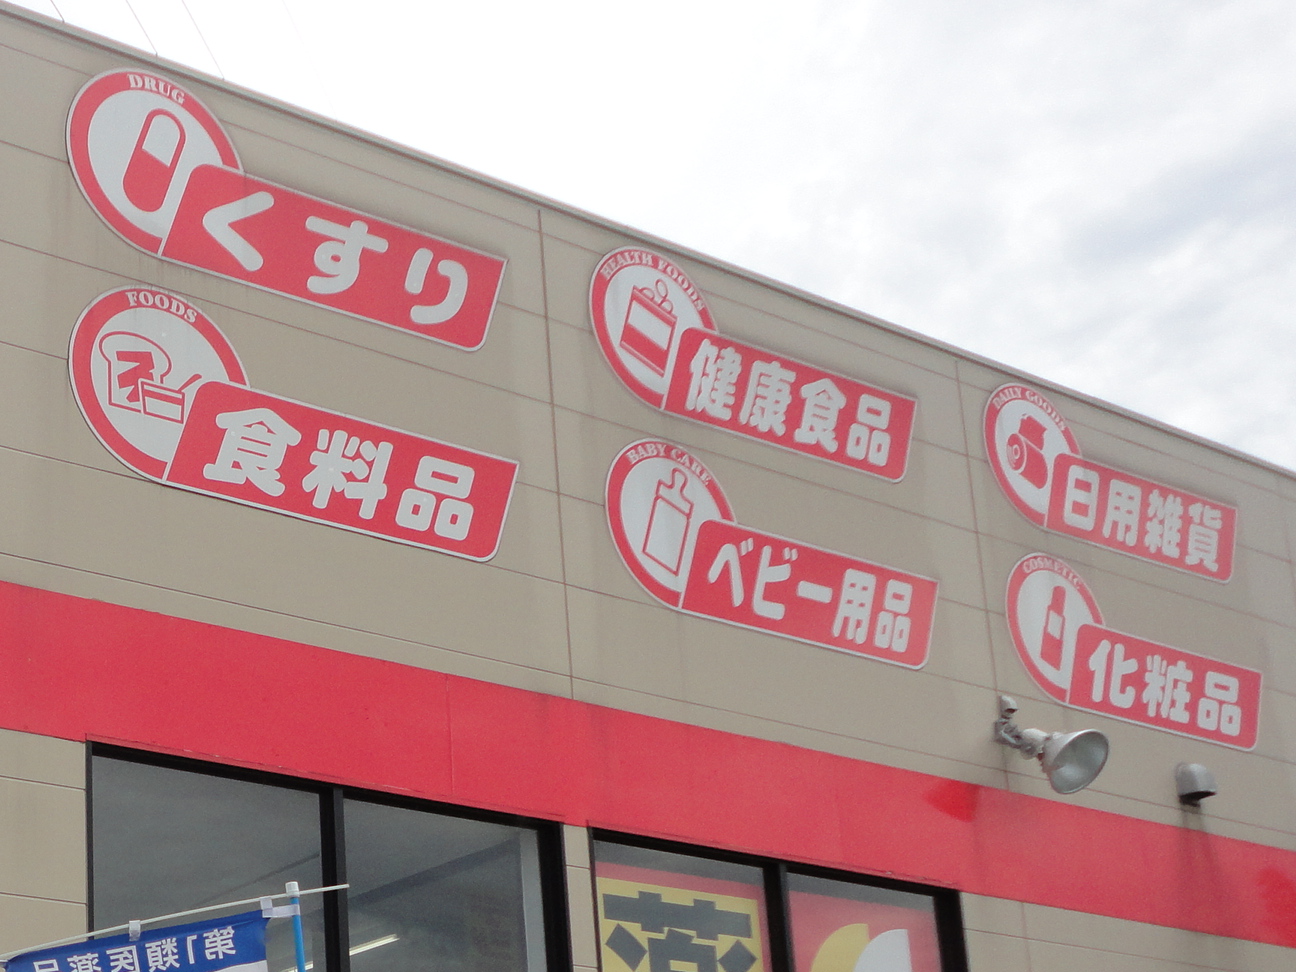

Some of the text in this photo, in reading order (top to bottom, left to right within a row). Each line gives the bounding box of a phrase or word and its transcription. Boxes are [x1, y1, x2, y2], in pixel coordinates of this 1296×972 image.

[127, 74, 185, 105] DRUG
[202, 190, 468, 325] くすり
[601, 249, 705, 312] HEALTH FOODS
[125, 290, 197, 324] FOODS
[685, 338, 893, 468] 健康食品
[991, 385, 1067, 433] DAILY GOODS
[203, 407, 476, 542] 食料品
[625, 440, 711, 488] BABY CARE
[1063, 463, 1224, 573] 日用雑貨
[708, 537, 913, 653] ベビー用品
[1022, 558, 1084, 591] COSMETIC
[1088, 639, 1242, 737] 化粧品
